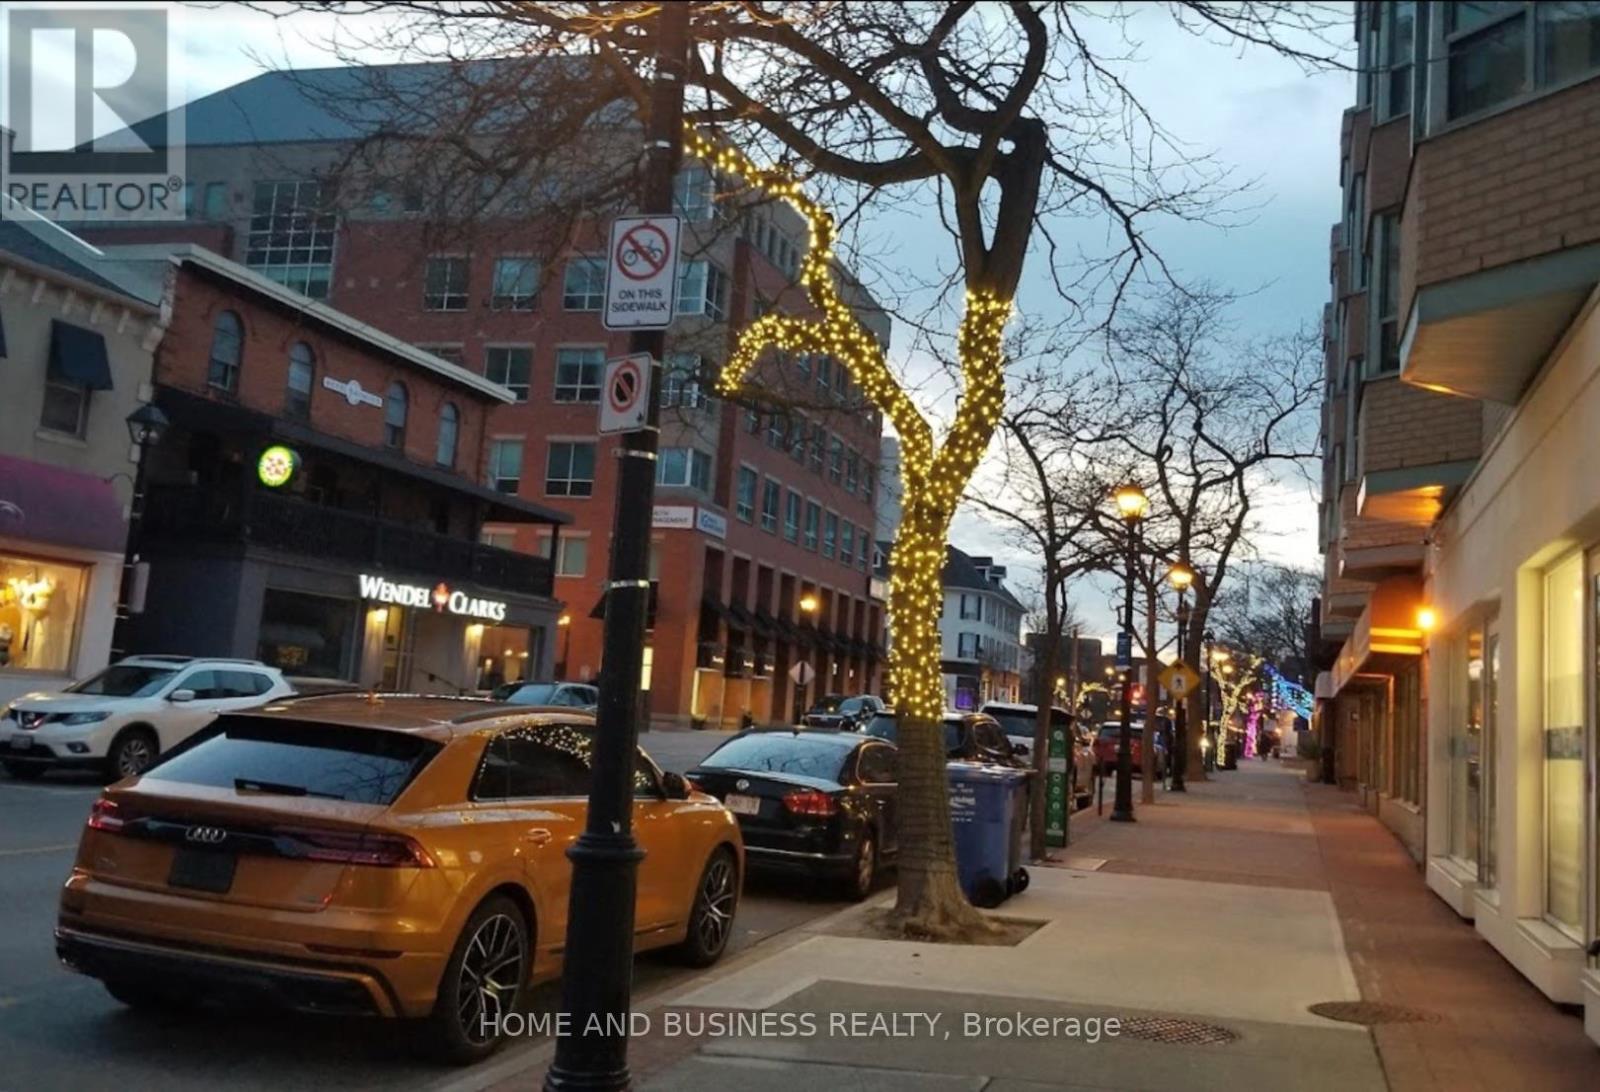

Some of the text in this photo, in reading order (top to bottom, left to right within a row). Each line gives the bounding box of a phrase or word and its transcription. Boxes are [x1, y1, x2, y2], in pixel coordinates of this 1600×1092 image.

[618, 288, 663, 300] ON THIS
[611, 301, 668, 313] SIDEWALK
[358, 574, 507, 621] WENDEL CLARKS
